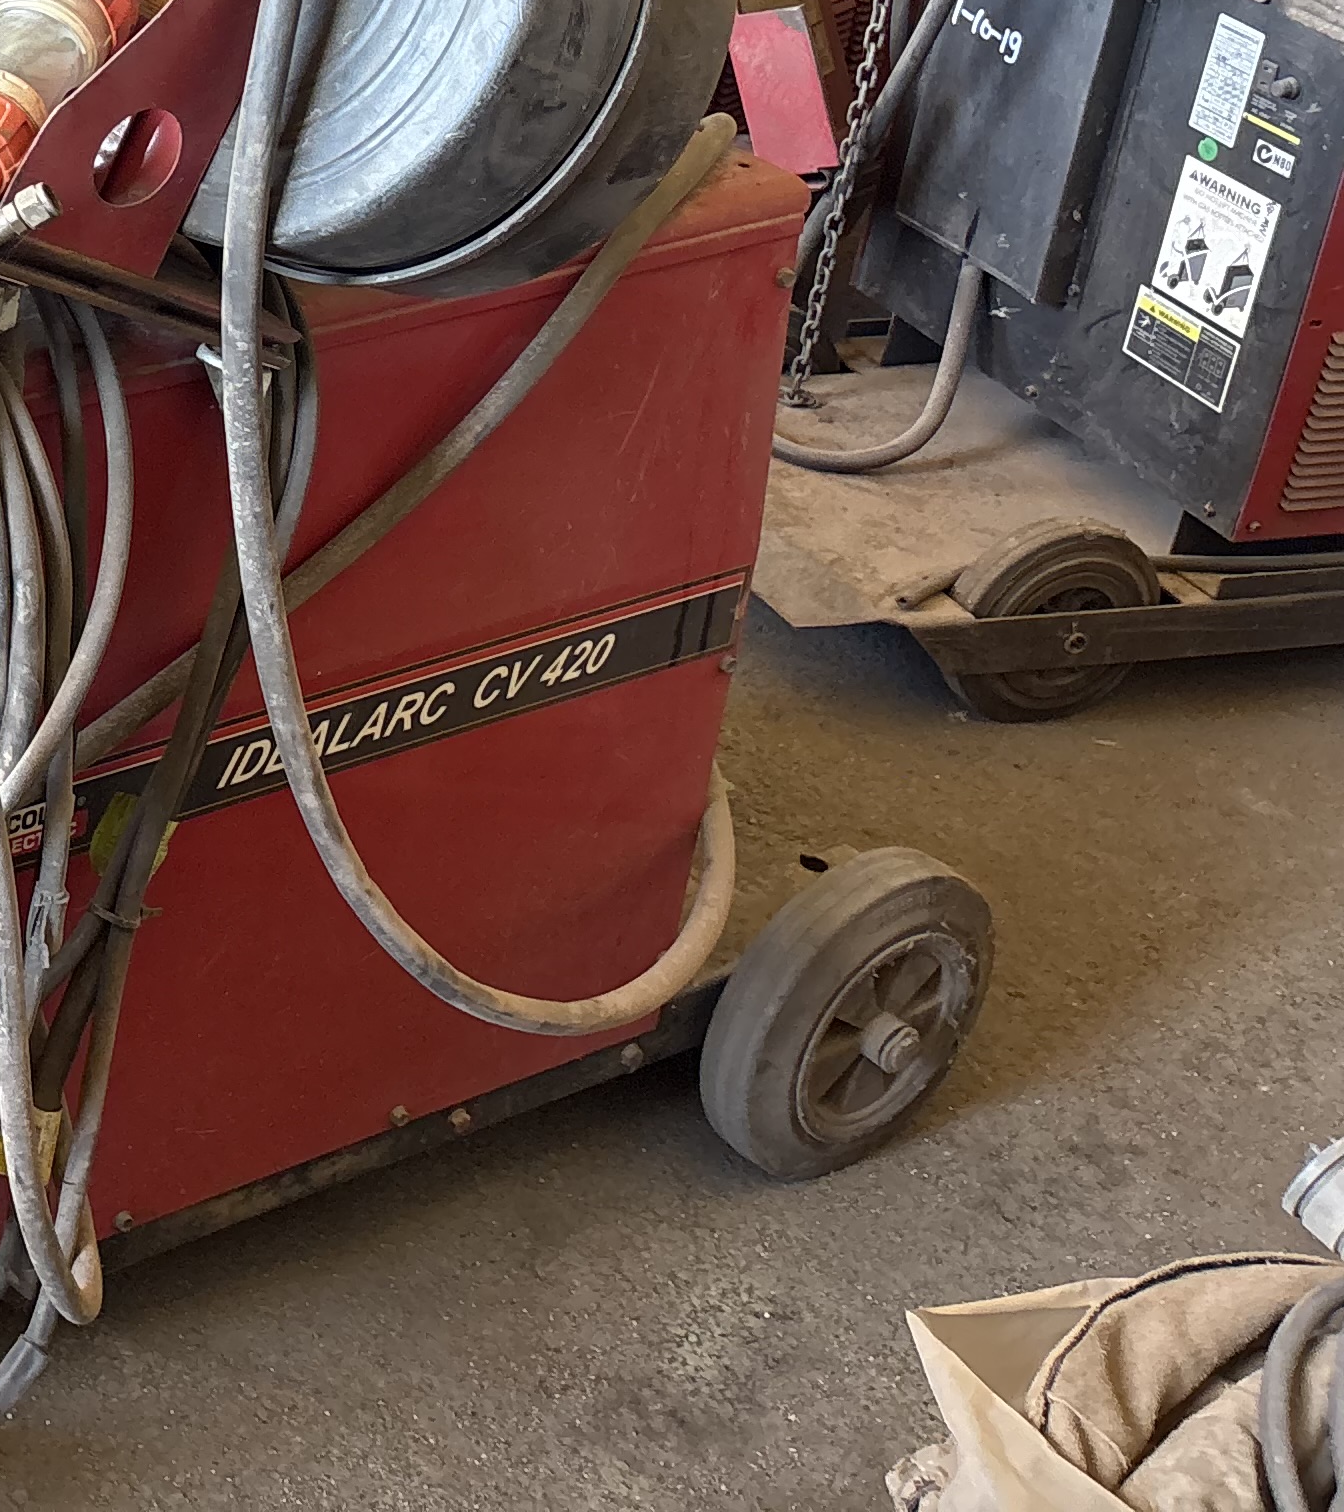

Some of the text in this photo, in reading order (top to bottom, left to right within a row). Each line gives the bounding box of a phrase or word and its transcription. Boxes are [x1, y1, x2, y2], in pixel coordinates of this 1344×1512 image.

[1199, 172, 1261, 215] WARNING
[473, 654, 542, 710] CV
[539, 634, 616, 687] 420
